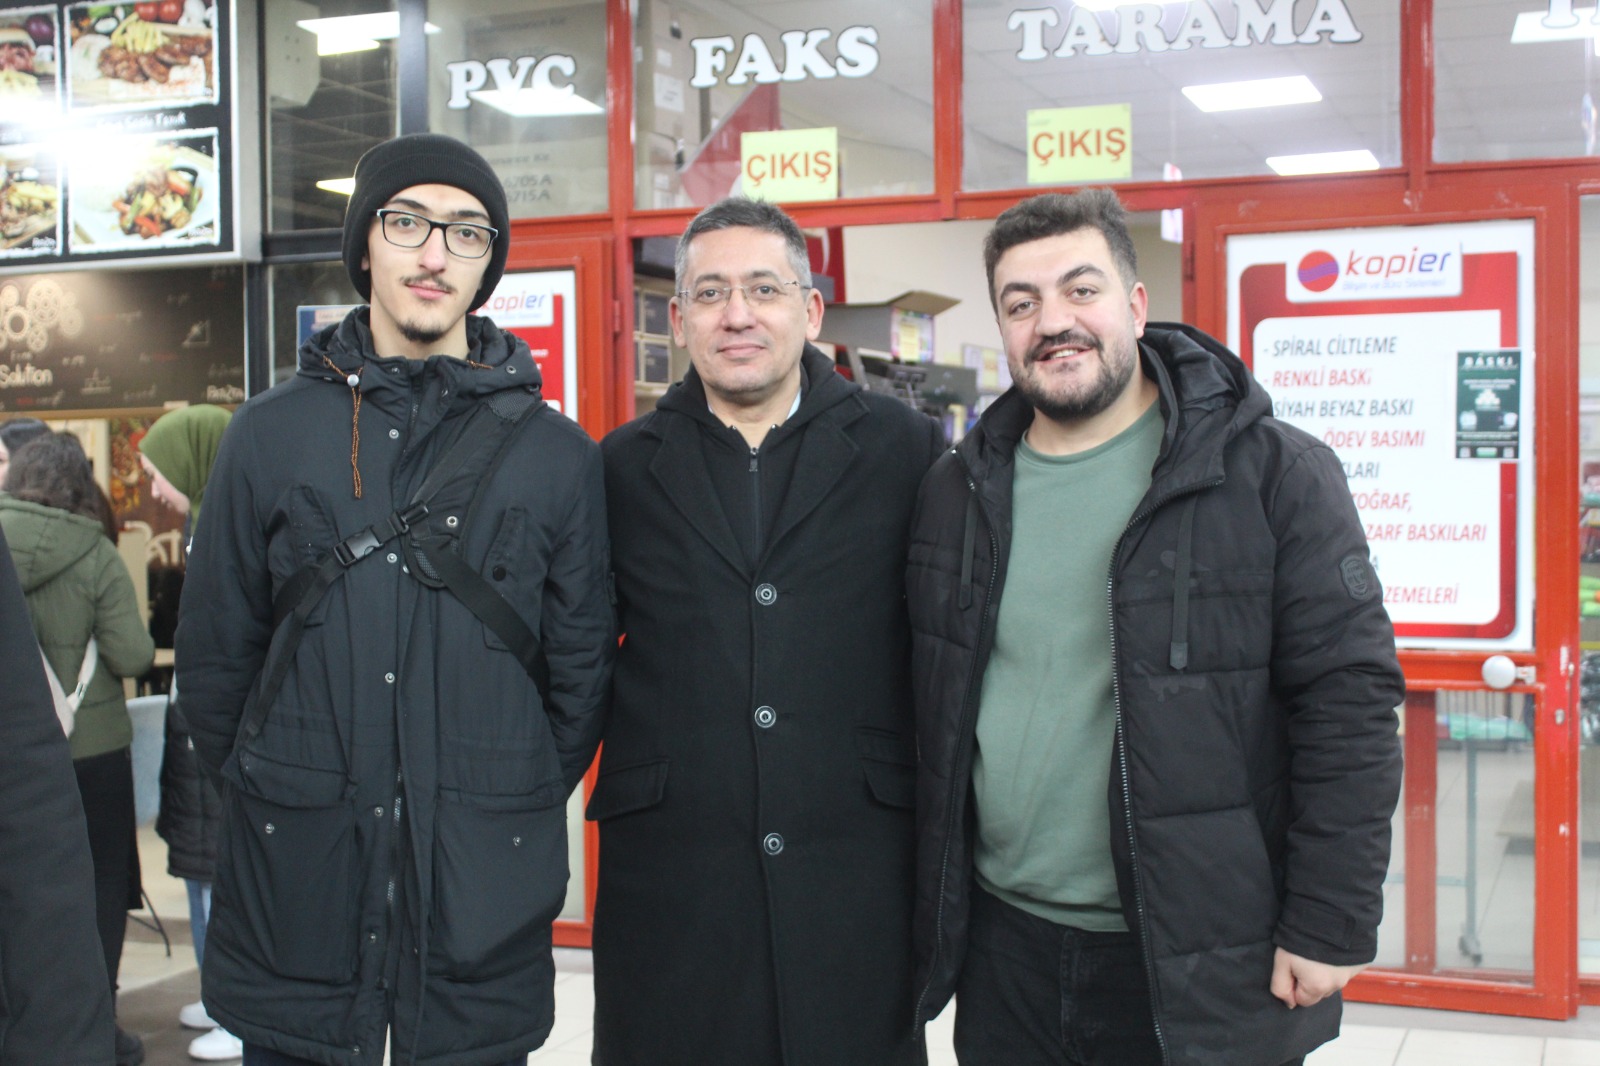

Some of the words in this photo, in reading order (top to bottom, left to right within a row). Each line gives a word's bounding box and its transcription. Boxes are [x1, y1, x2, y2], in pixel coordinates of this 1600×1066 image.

[1007, 0, 1364, 60] TARAMA
[690, 25, 880, 88] FAKS
[447, 53, 577, 109] PVC
[1033, 128, 1126, 166] ÇIKIŞ
[747, 150, 832, 187] ÇIKIŞ
[1346, 247, 1451, 278] kopier
[1273, 335, 1322, 357] SPİRAL
[1327, 333, 1397, 356] CİLTLEME
[1272, 365, 1325, 387] RENKLİ
[1274, 397, 1315, 418] SİYAH
[1319, 399, 1366, 417] BEYAZ
[1369, 398, 1414, 416] BASKI
[1323, 427, 1366, 447] ÖDEV
[1371, 429, 1425, 447] BASIMI
[1366, 524, 1403, 540] ZARF
[1407, 523, 1487, 541] BASKILARI
[1384, 583, 1460, 604] ZEMELERİ
